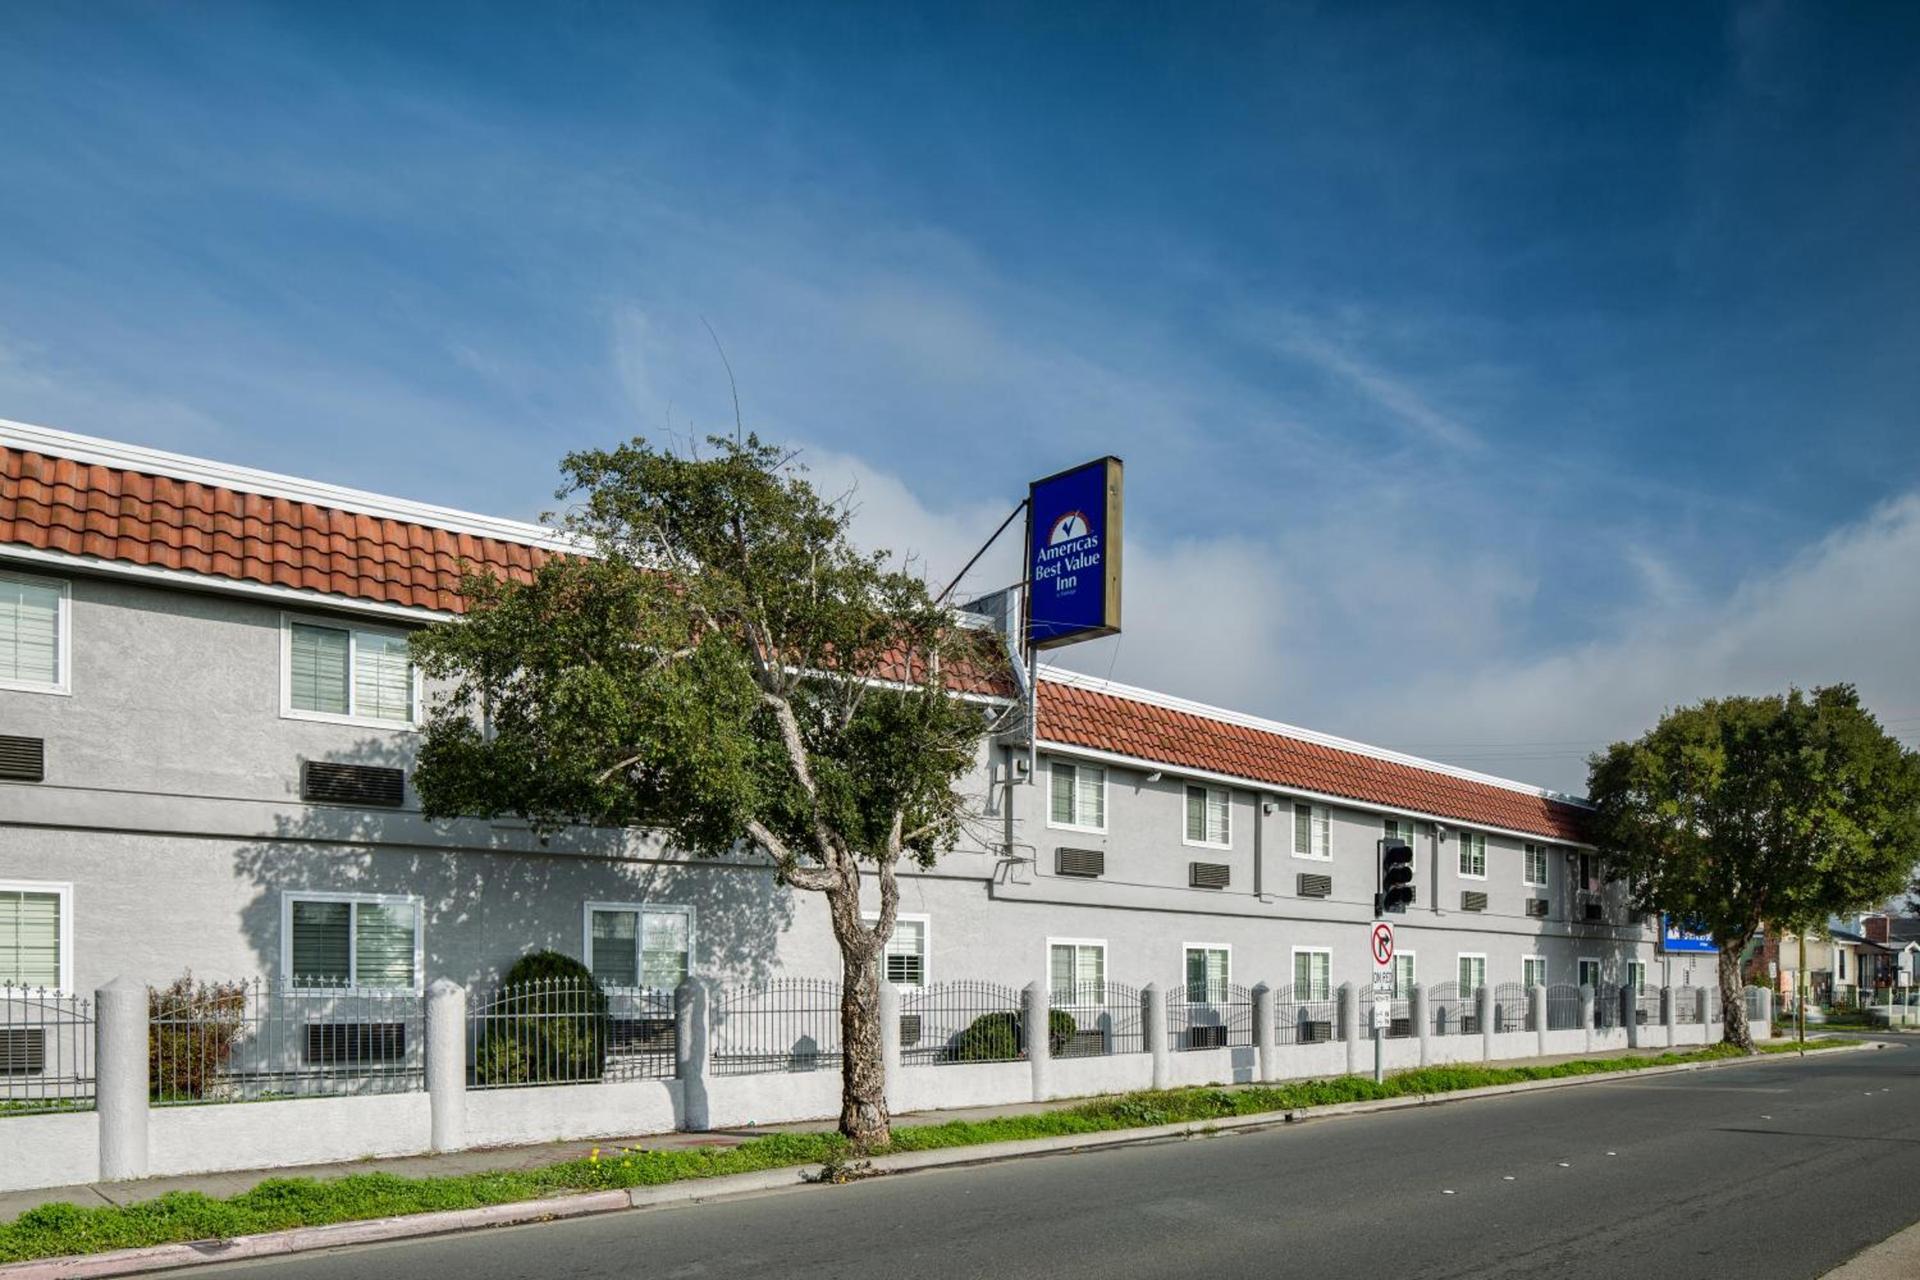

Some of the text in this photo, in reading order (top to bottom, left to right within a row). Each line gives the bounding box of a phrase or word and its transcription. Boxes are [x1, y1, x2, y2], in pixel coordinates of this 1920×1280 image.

[1037, 535, 1098, 563] Americas
[1036, 551, 1100, 580] Best Value
[1056, 576, 1077, 591] Inn
